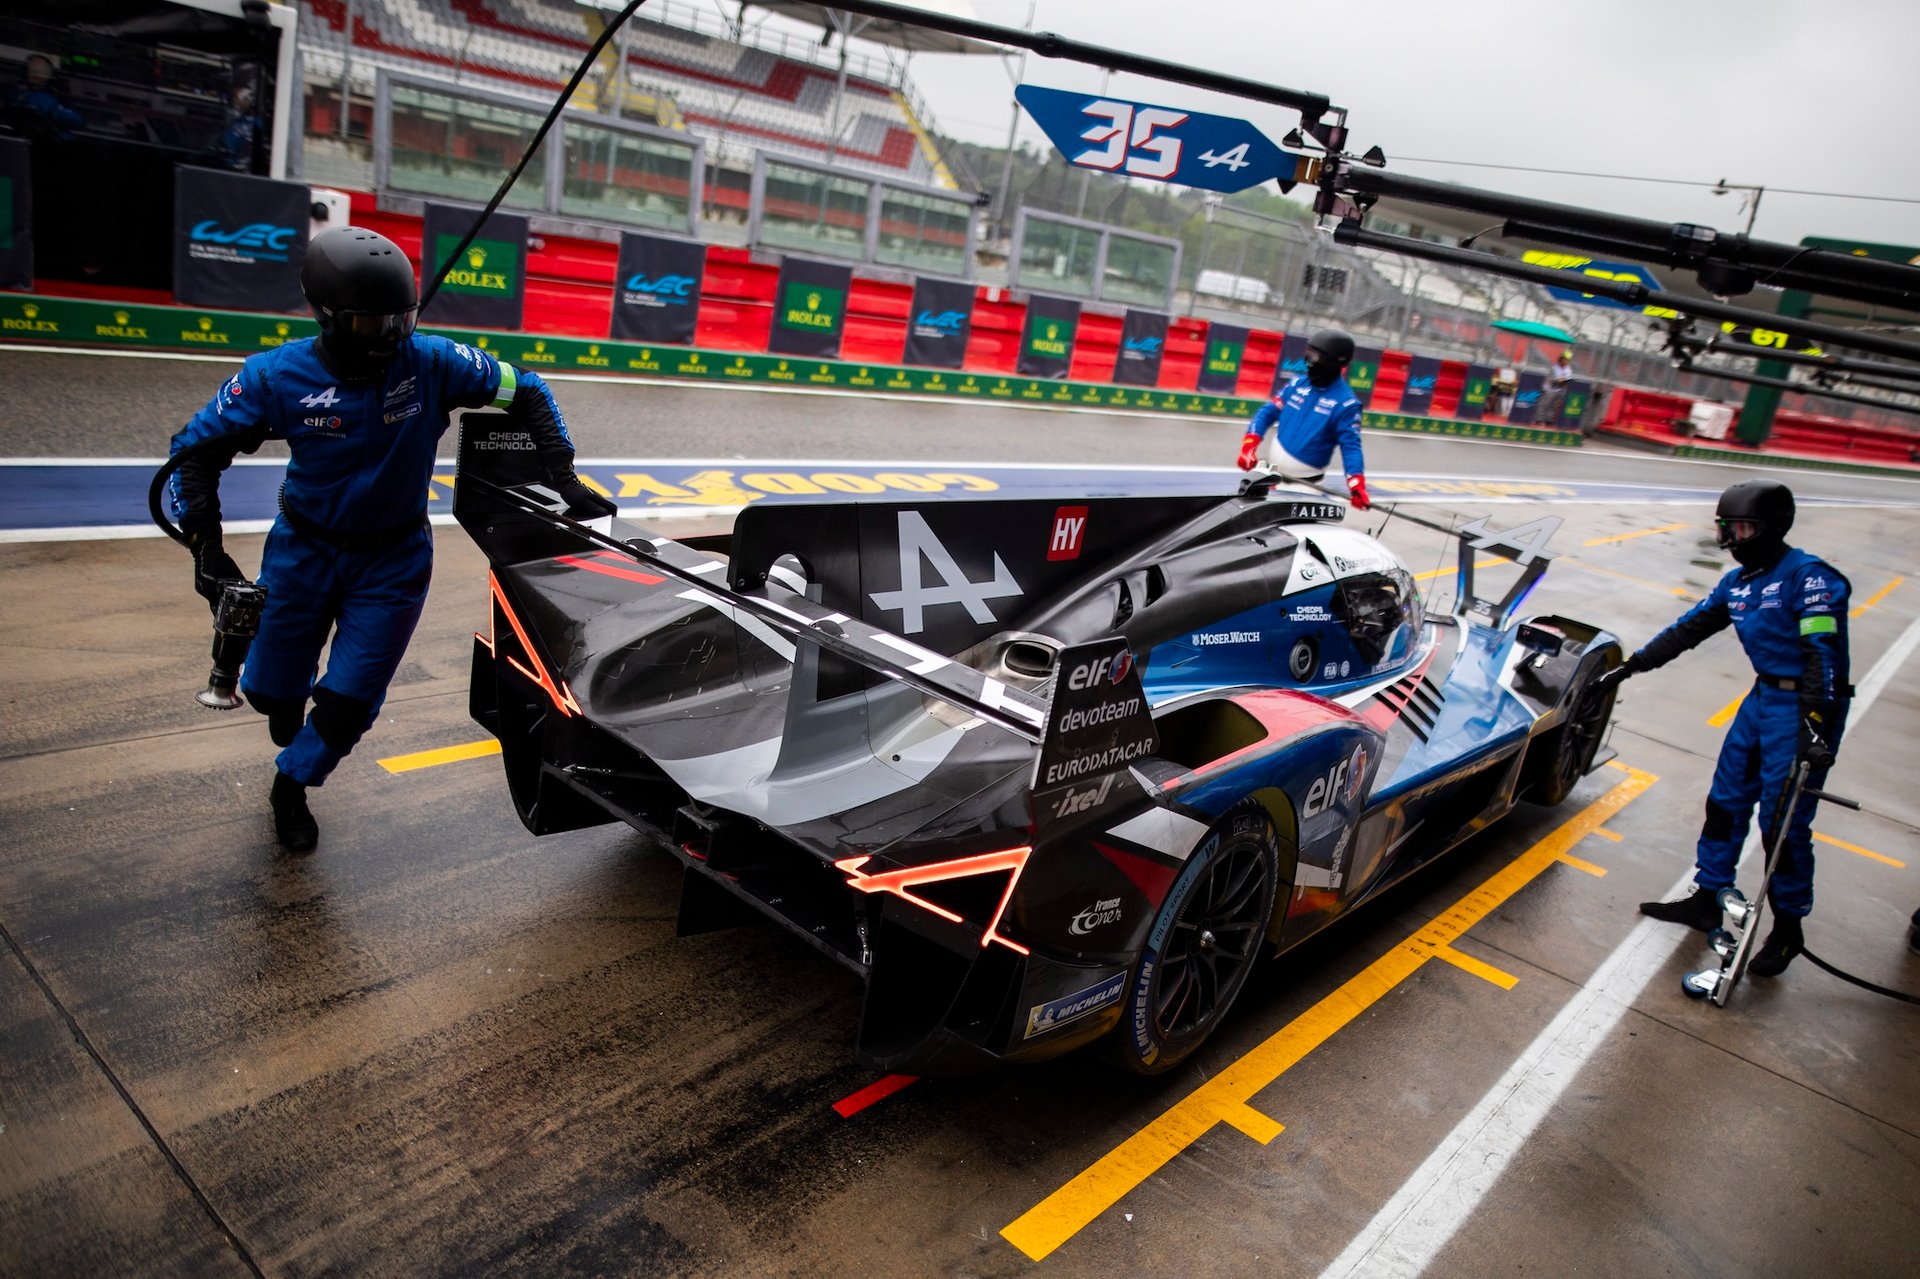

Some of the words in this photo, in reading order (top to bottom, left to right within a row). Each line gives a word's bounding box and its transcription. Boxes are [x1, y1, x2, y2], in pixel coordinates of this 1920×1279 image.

[1072, 100, 1190, 179] 35
[190, 220, 297, 250] WEC
[443, 271, 506, 289] ROLEX
[625, 273, 696, 296] WEC
[2, 318, 59, 332] ROLEX
[787, 310, 832, 327] ROLEX
[96, 325, 148, 338] ROLEX
[181, 331, 229, 344] ROLEX
[260, 335, 299, 346] ROL
[522, 352, 556, 363] ROLEX
[577, 356, 609, 367] ROLEX
[629, 359, 660, 370] ROLEX
[678, 363, 707, 373] ROLEX
[304, 417, 327, 427] elf
[474, 441, 536, 450] TECHNOLO
[1299, 506, 1345, 517] ALTEN
[1052, 517, 1084, 551] HY
[1804, 594, 1820, 604] elf
[1289, 613, 1332, 621] TECHNOLOGY
[1068, 656, 1112, 691] elf
[1324, 665, 1338, 676] FIA
[1060, 698, 1140, 733] devoteam
[1047, 738, 1153, 784] EURODATACAR
[1056, 773, 1115, 818] ixell
[1303, 759, 1348, 819] elf
[1095, 897, 1121, 913] France
[1155, 913, 1171, 941] PILOT
[1170, 877, 1190, 909] SPORT
[1057, 982, 1121, 1019] MICHELIN
[1136, 961, 1154, 1049] MICHELIN
